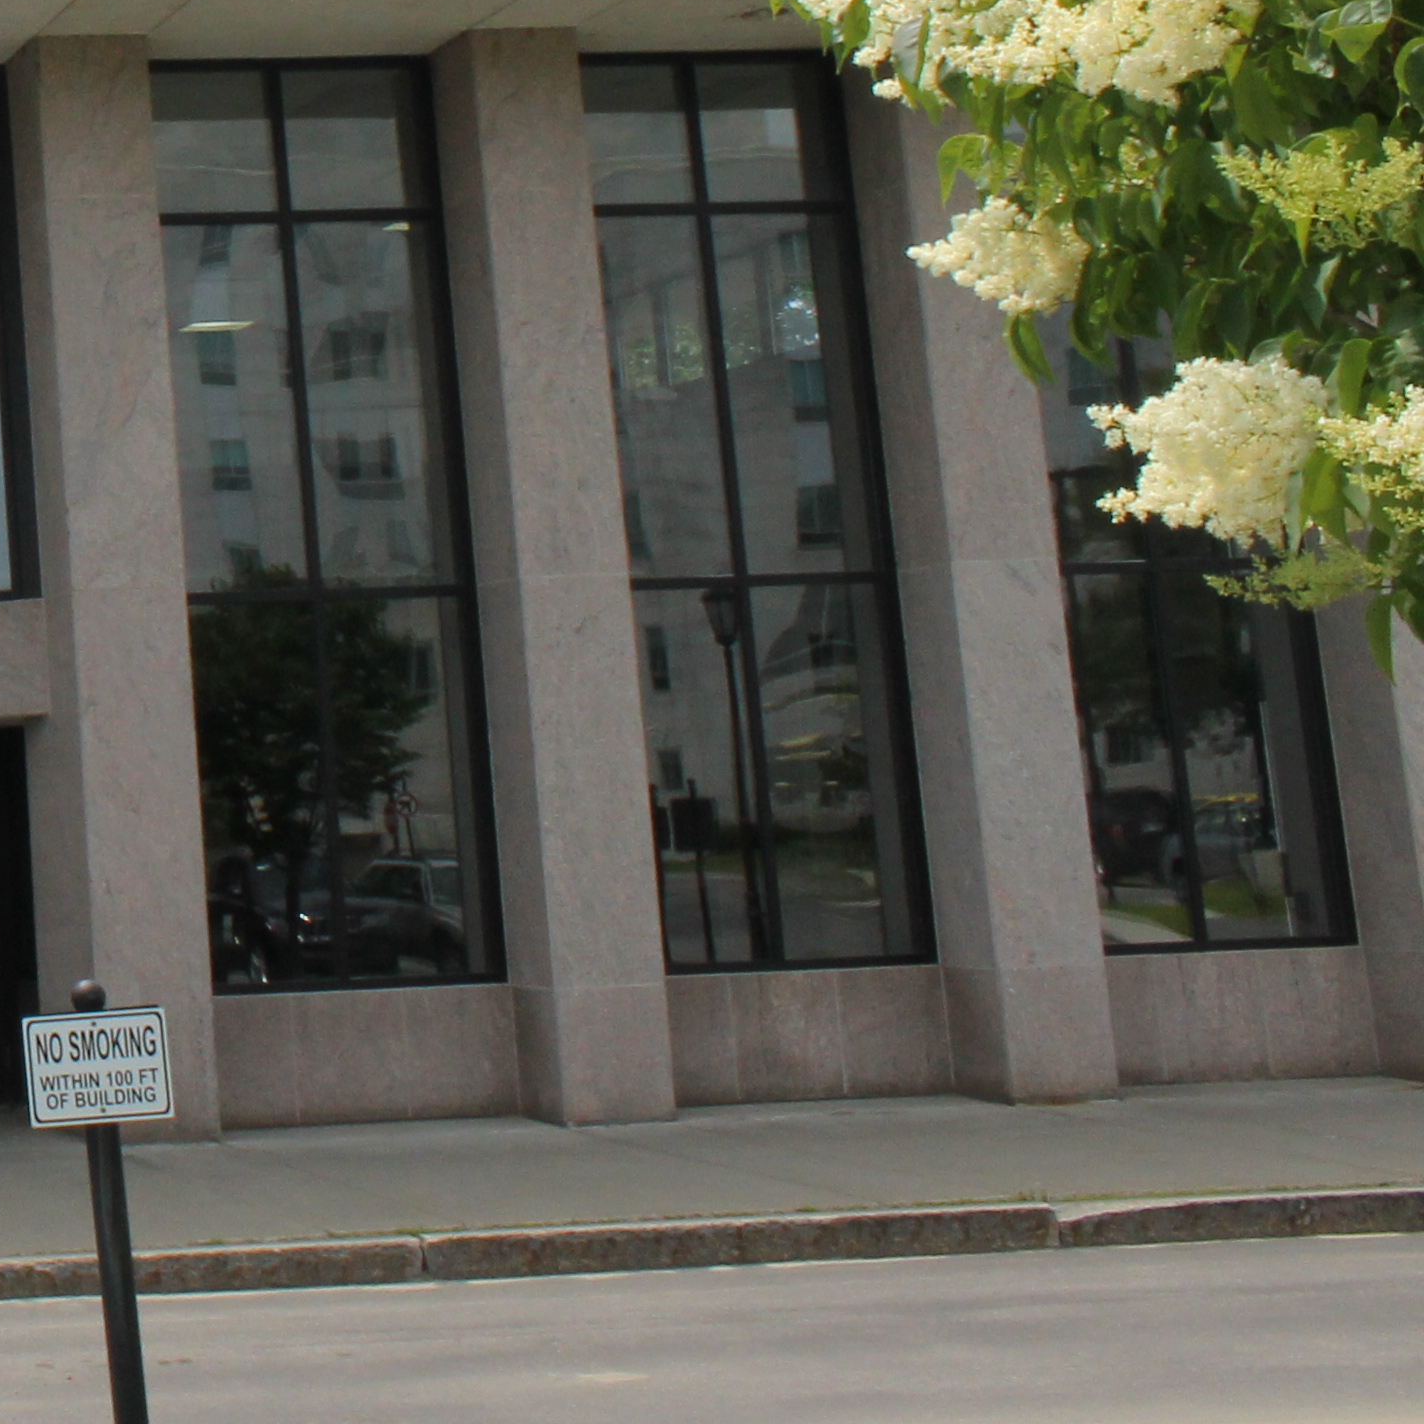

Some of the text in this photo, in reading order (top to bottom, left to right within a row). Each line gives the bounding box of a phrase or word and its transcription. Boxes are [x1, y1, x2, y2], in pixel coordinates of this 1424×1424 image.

[35, 1025, 157, 1064] NO SMOKING
[39, 1068, 158, 1092] WITHIN 100 FT
[46, 1086, 156, 1109] OF BUILDING
